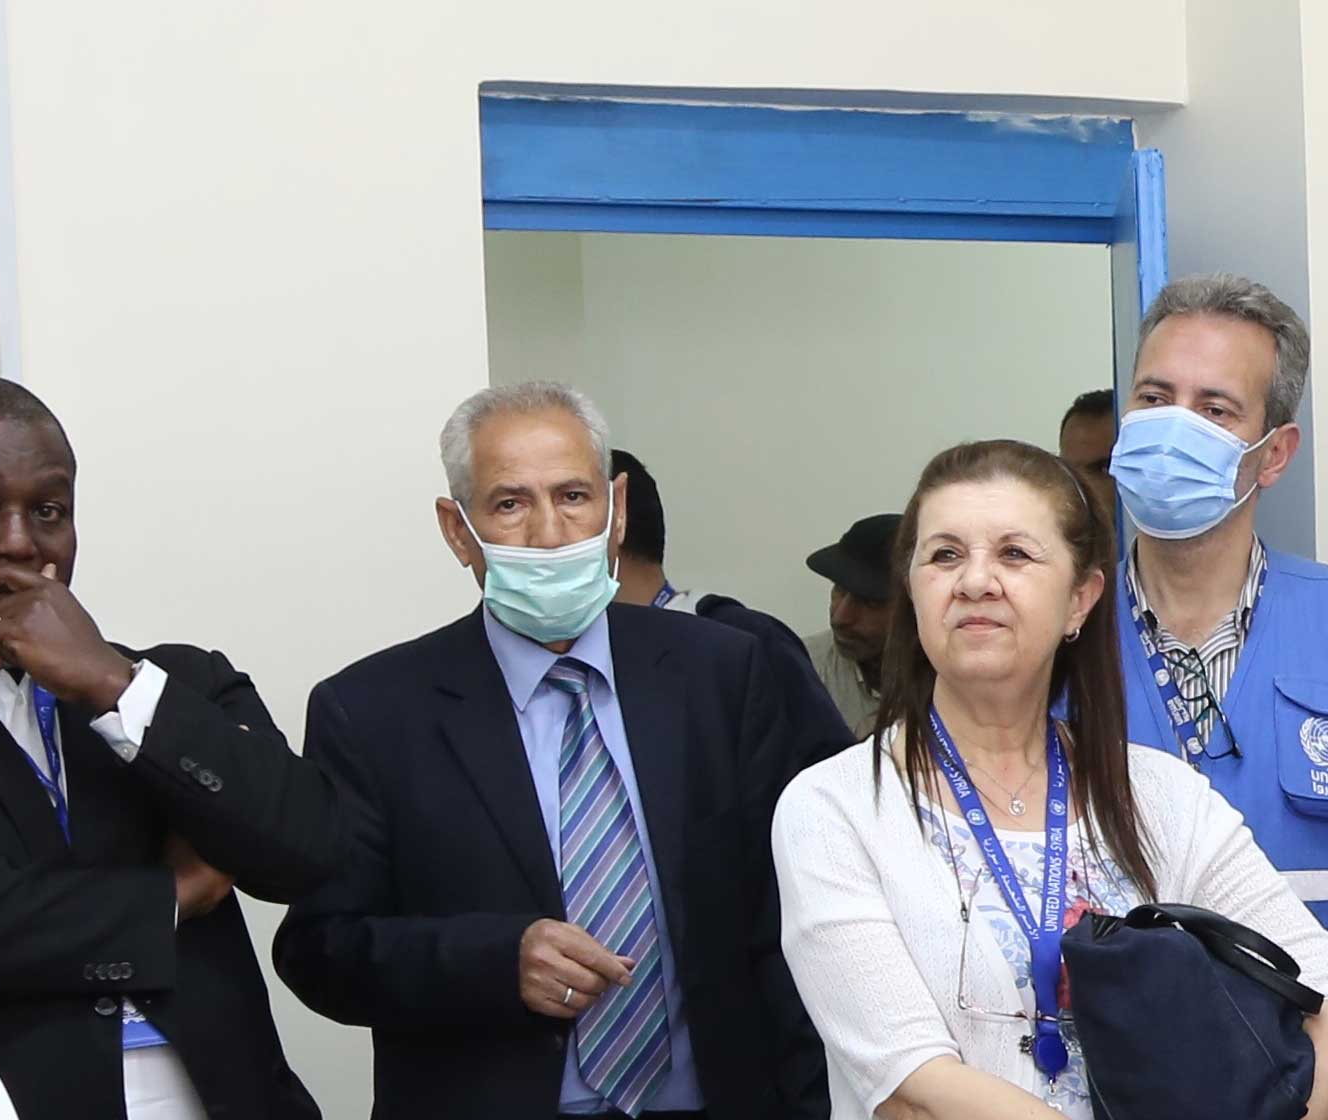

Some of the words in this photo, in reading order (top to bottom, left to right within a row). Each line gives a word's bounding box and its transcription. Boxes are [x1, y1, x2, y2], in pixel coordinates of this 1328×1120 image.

[1050, 827, 1064, 852] SYRIA
[1047, 855, 1063, 896] NATIONS
[1044, 896, 1060, 932] UNITED
